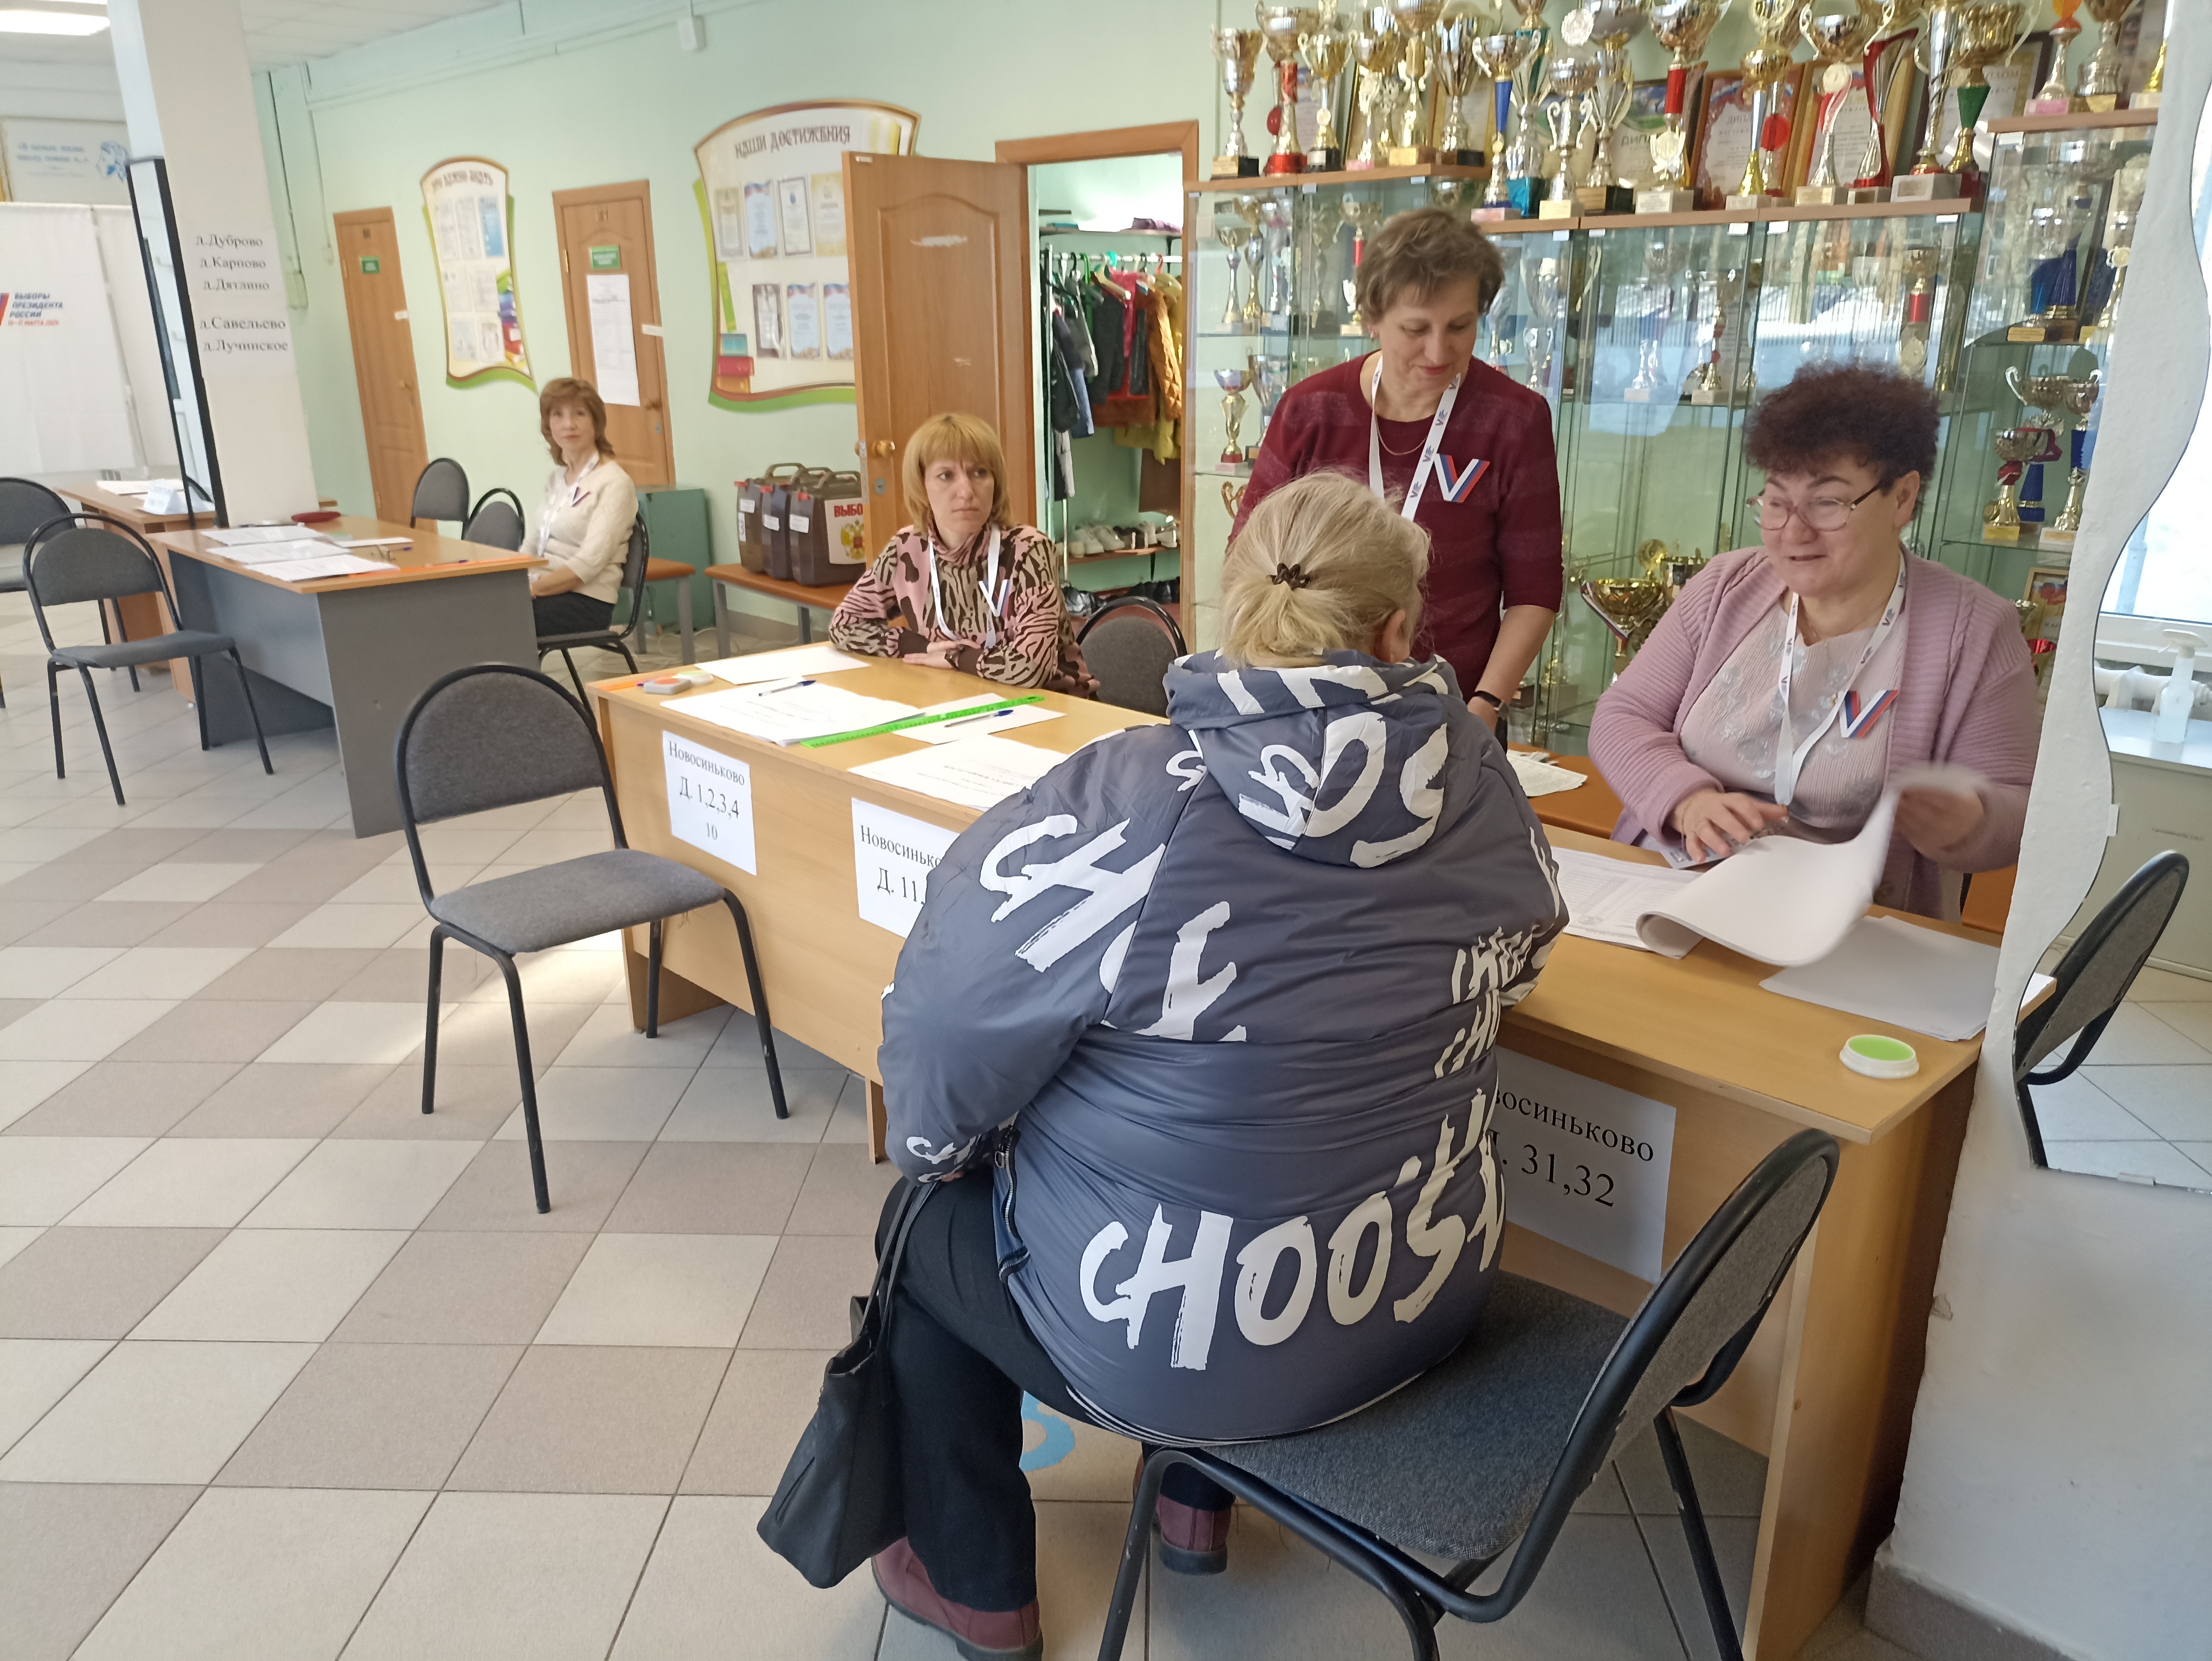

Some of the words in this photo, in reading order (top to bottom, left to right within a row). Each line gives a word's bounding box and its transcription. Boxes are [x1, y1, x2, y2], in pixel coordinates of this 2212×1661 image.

[735, 135, 767, 159] НАШИ
[770, 125, 850, 153] ДОСТИЖЕНИЯ
[834, 503, 863, 518] ВЫБО
[669, 740, 745, 786] Новосиньково
[680, 776, 693, 801] Д.
[697, 784, 740, 819] 1,2,3,4
[706, 821, 718, 841] 10
[861, 824, 941, 869] Новосинько
[877, 867, 895, 896] Д.
[1495, 1088, 1654, 1162] осиньково
[1521, 1143, 1615, 1207] 31,32
